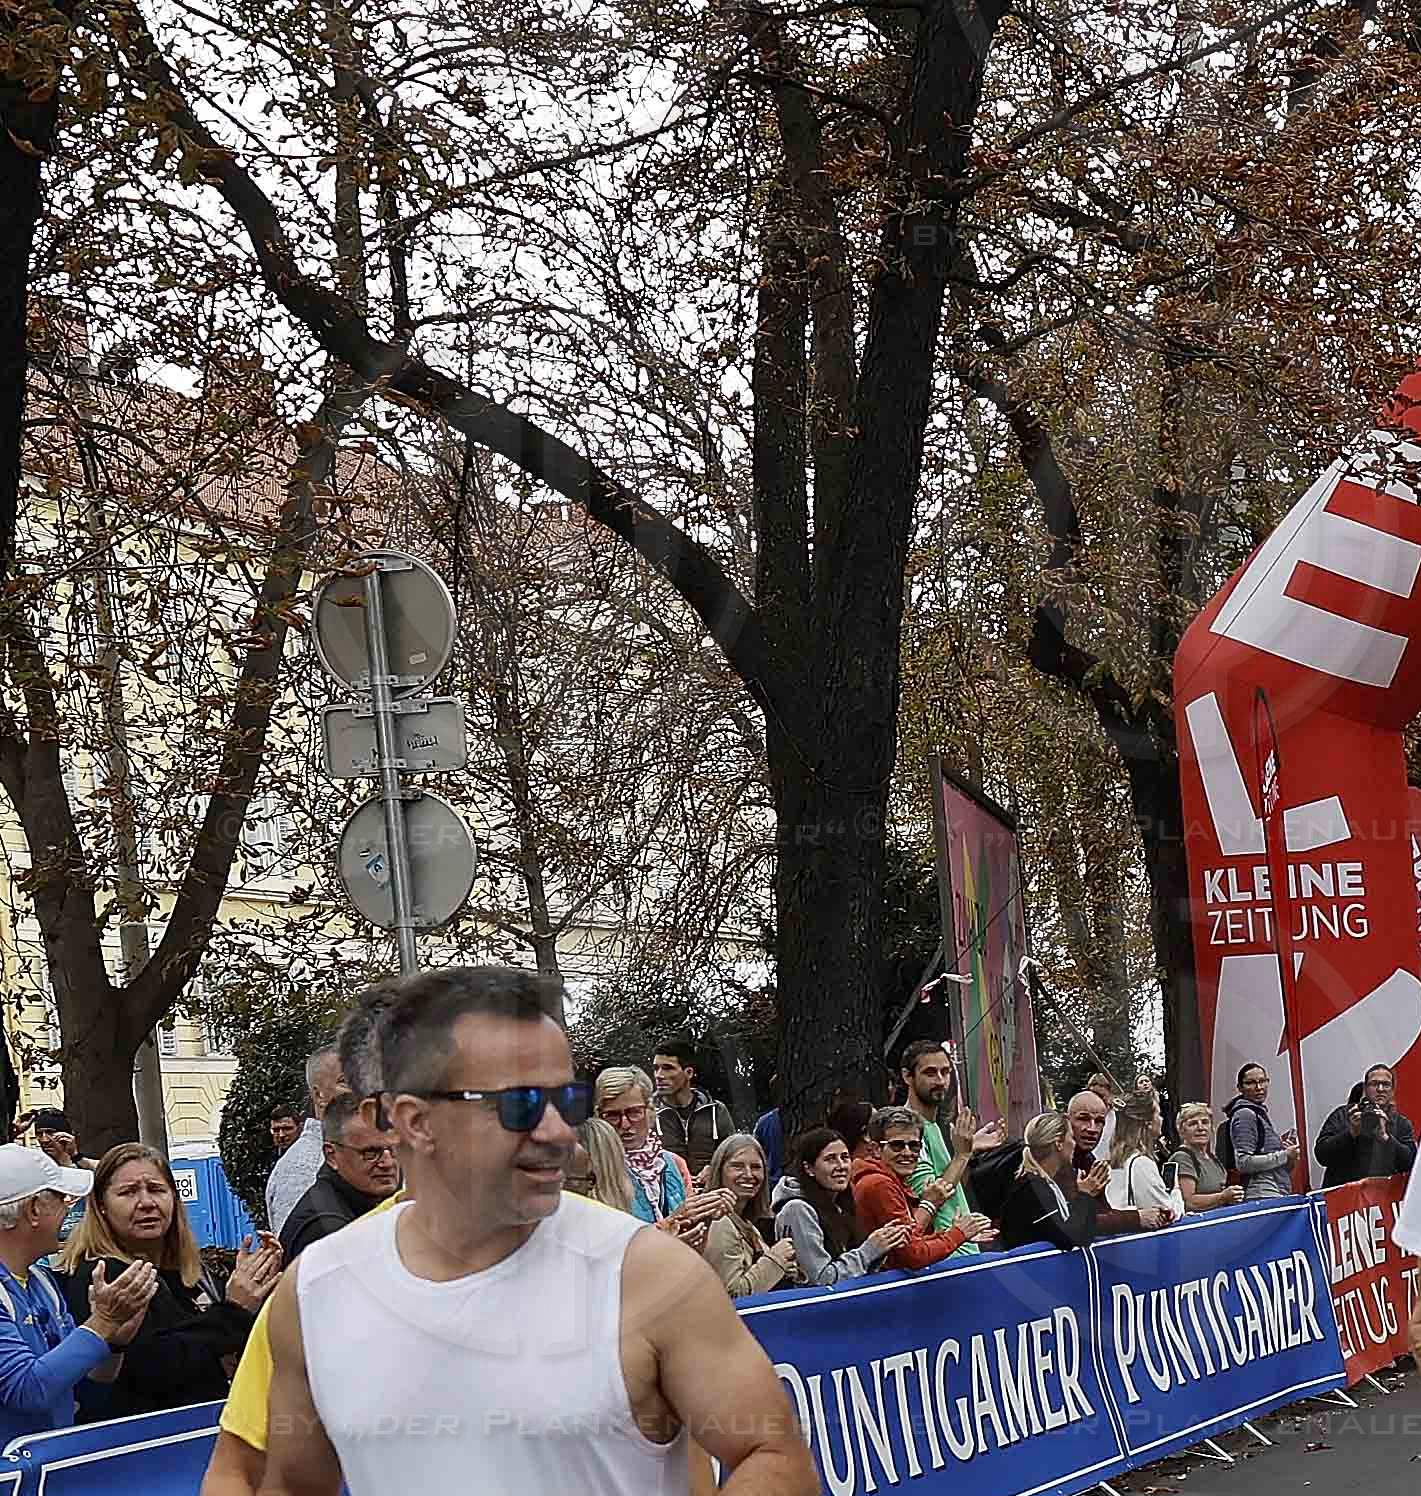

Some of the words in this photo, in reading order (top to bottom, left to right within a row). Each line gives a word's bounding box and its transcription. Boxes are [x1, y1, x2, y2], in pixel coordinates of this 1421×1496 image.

[1204, 862, 1366, 905] KLEINE
[1328, 1205, 1386, 1284] LEINE
[1111, 1248, 1327, 1404] PUNTIGAMER
